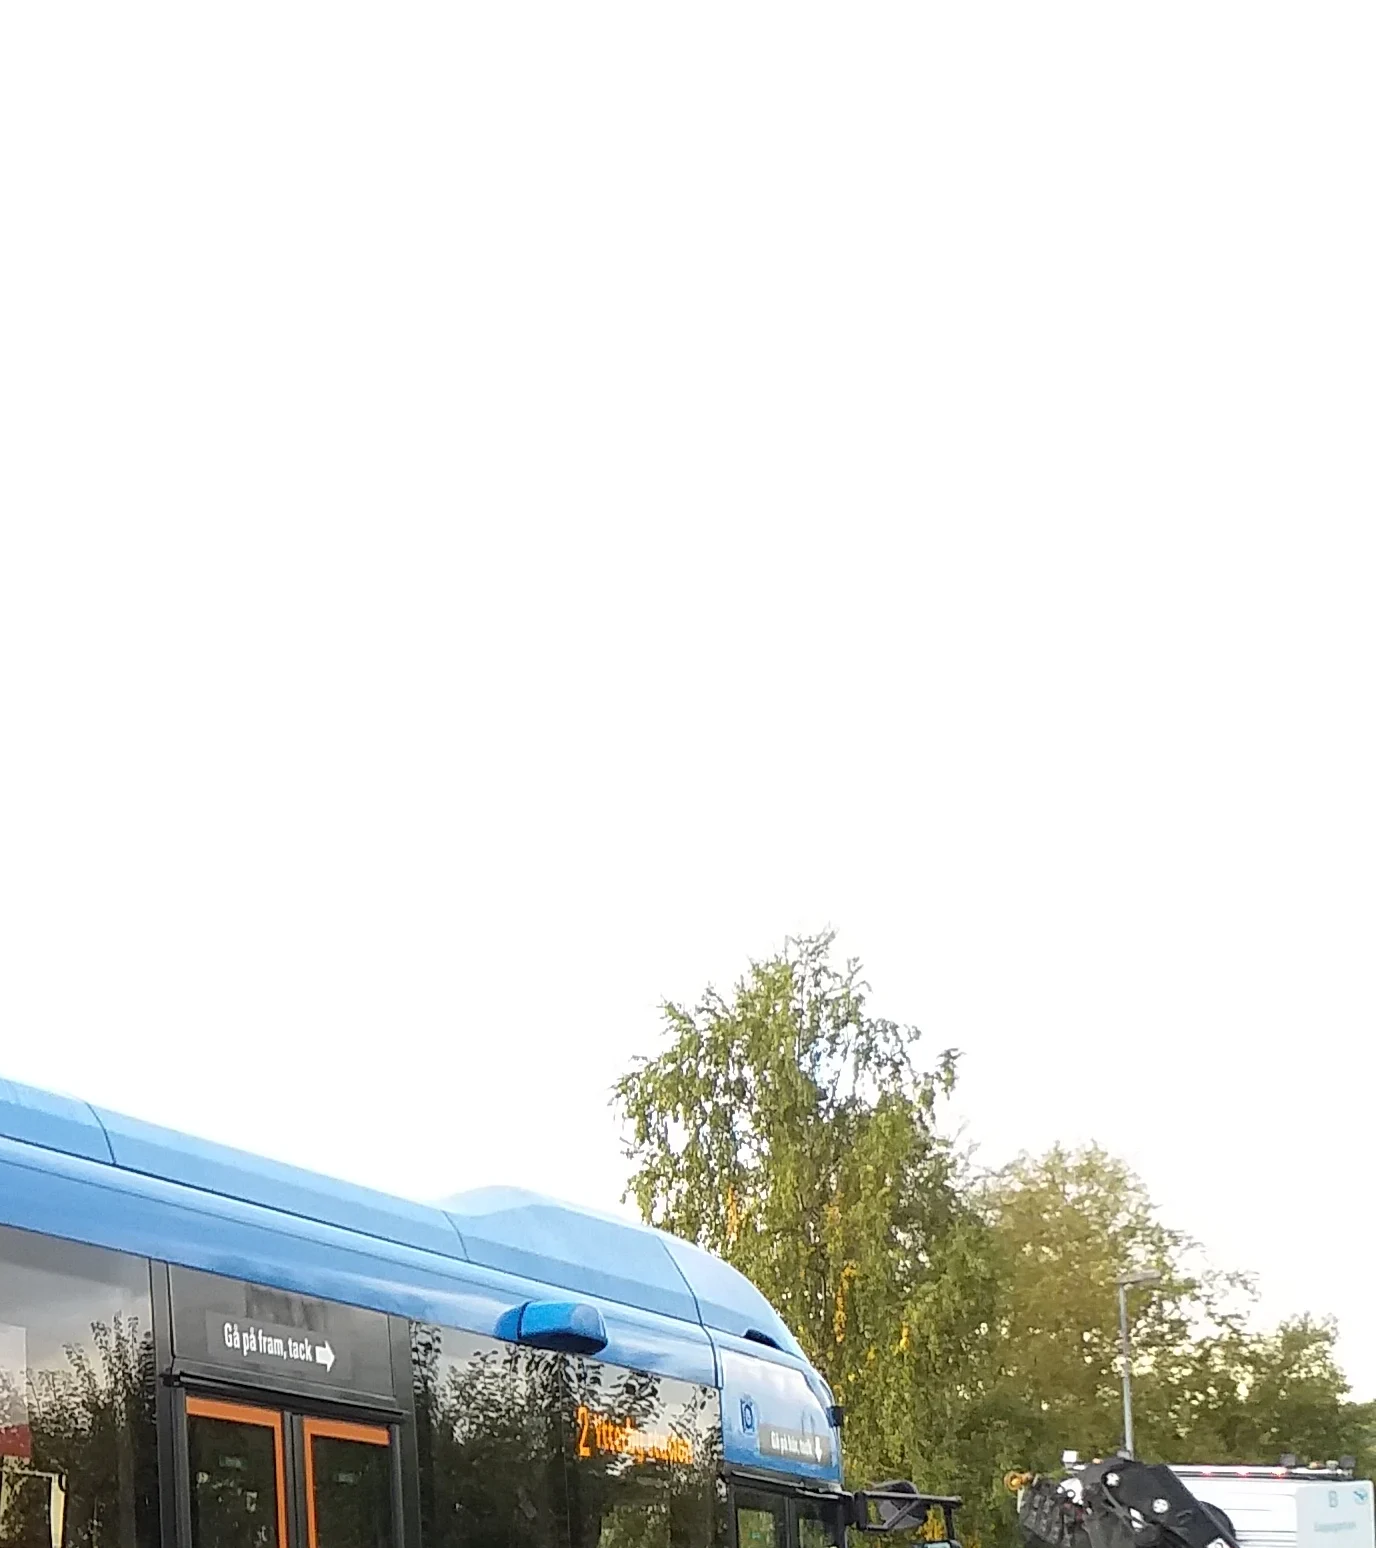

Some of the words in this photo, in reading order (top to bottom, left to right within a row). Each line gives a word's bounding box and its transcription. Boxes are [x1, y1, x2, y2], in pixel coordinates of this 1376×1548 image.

[224, 1322, 240, 1348] Gå
[242, 1326, 257, 1356] på
[258, 1329, 287, 1360] fram,
[288, 1337, 313, 1362] tack
[577, 1405, 590, 1457] 2
